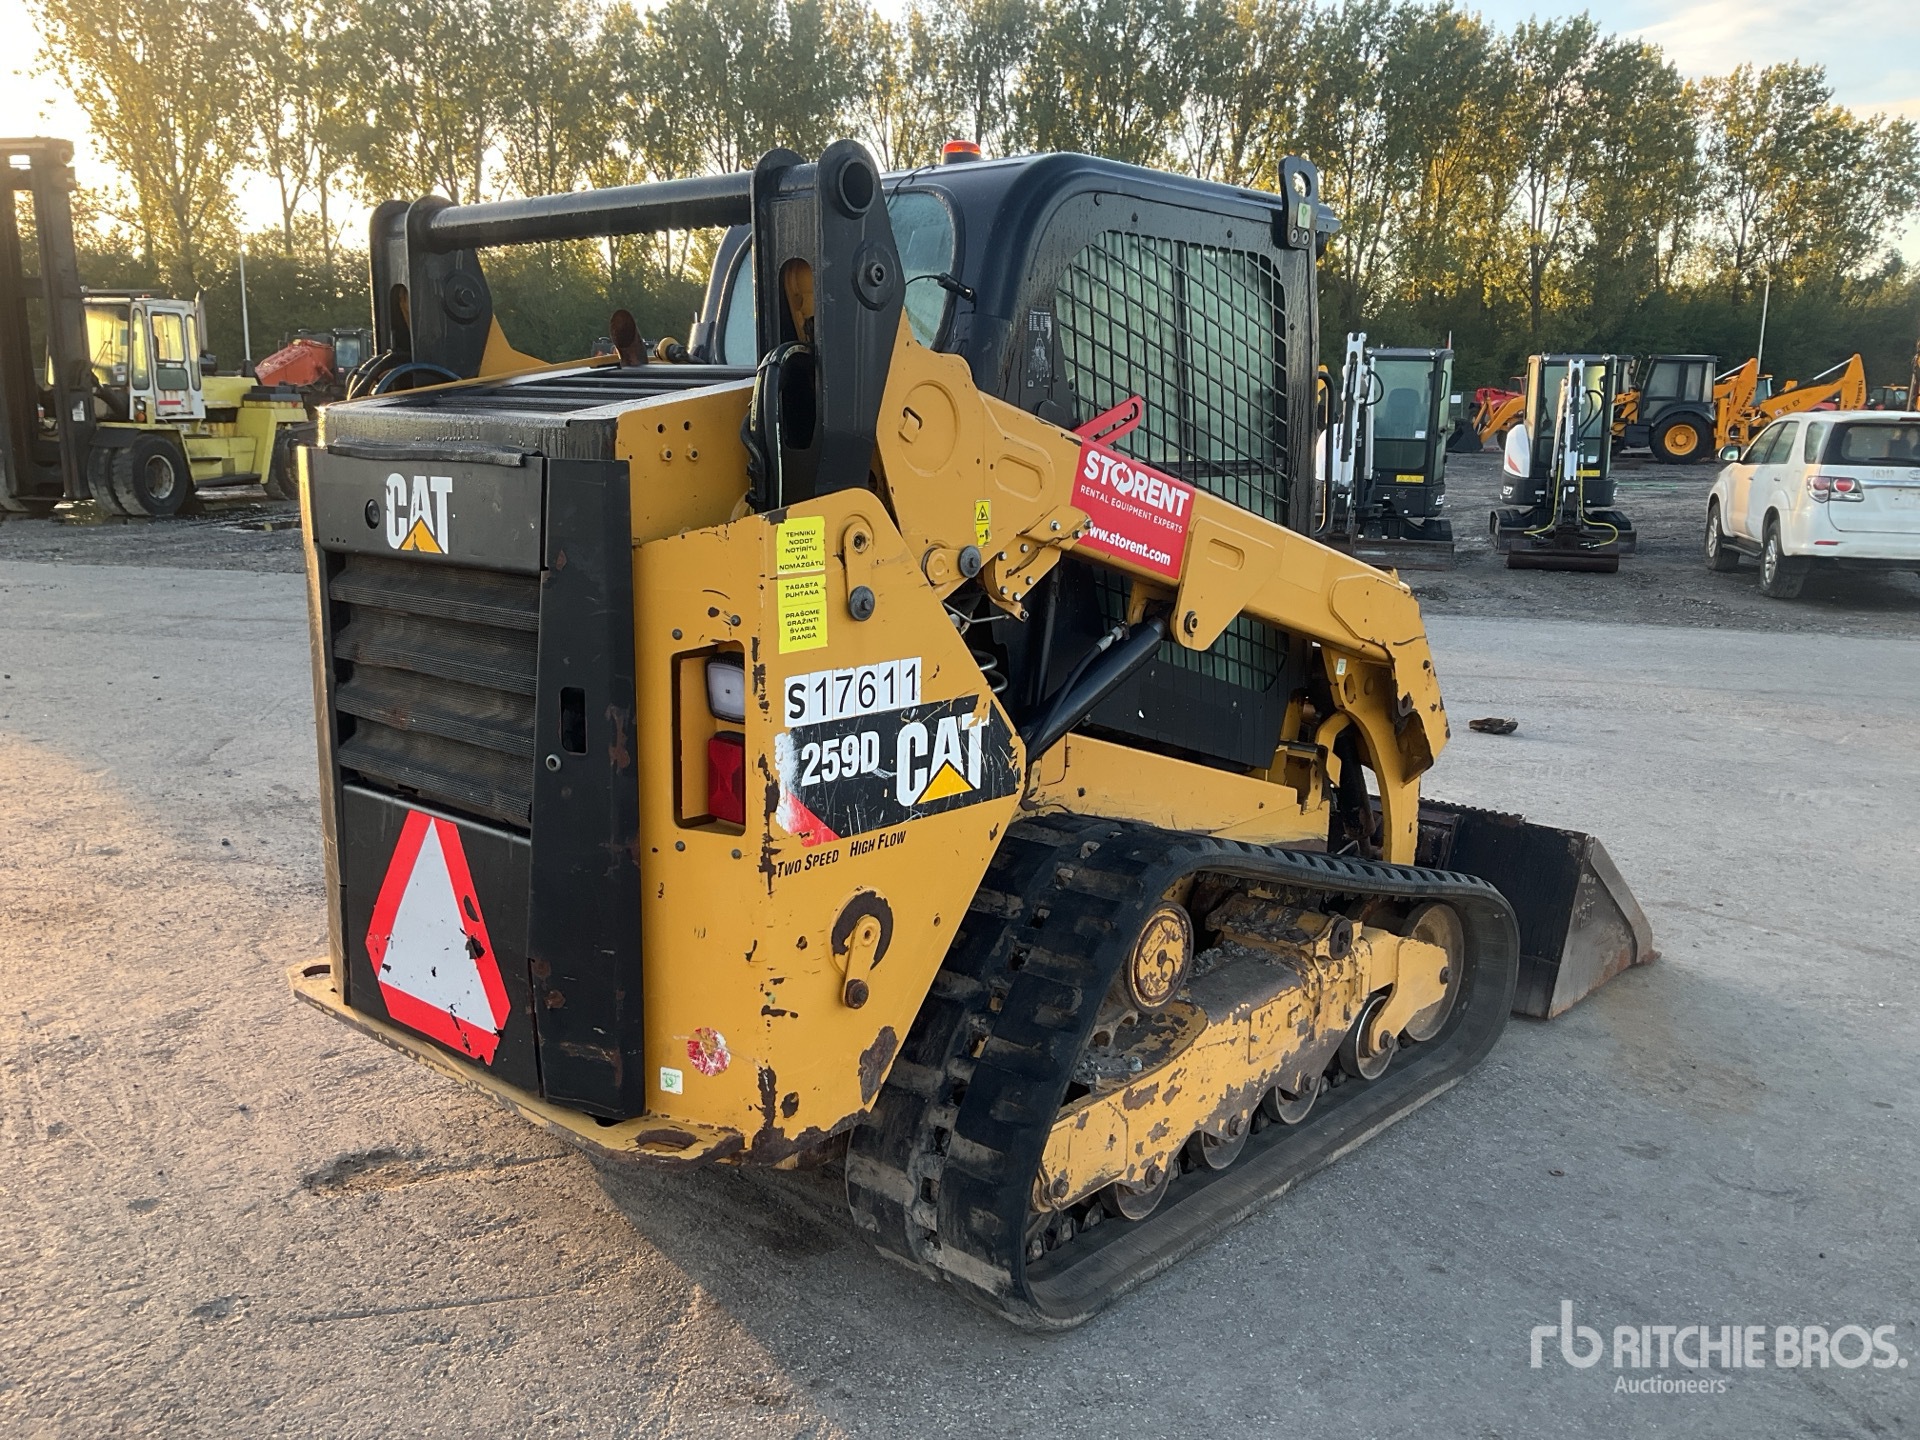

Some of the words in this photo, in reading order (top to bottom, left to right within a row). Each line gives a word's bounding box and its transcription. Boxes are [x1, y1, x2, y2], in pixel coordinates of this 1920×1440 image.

[1083, 450, 1190, 517] STORENT
[385, 472, 453, 554] CAT
[1080, 484, 1109, 504] RENTAL
[1110, 497, 1153, 521] EQUIPMENT
[1153, 515, 1183, 534] EXPERTS
[785, 529, 816, 538] TEHNIKU
[788, 537, 814, 545] NODOT
[1086, 525, 1171, 566] ww.storent.com
[785, 581, 819, 591] TAGASTA
[785, 589, 819, 599] PUHTANA
[785, 608, 820, 619] PRAŠOME
[788, 663, 916, 720] S17611
[801, 730, 880, 787] 259D
[896, 711, 991, 807] CAT
[777, 859, 802, 878] TWO
[804, 849, 839, 871] SPEED
[849, 838, 876, 857] HIGH
[877, 830, 907, 850] FLOW
